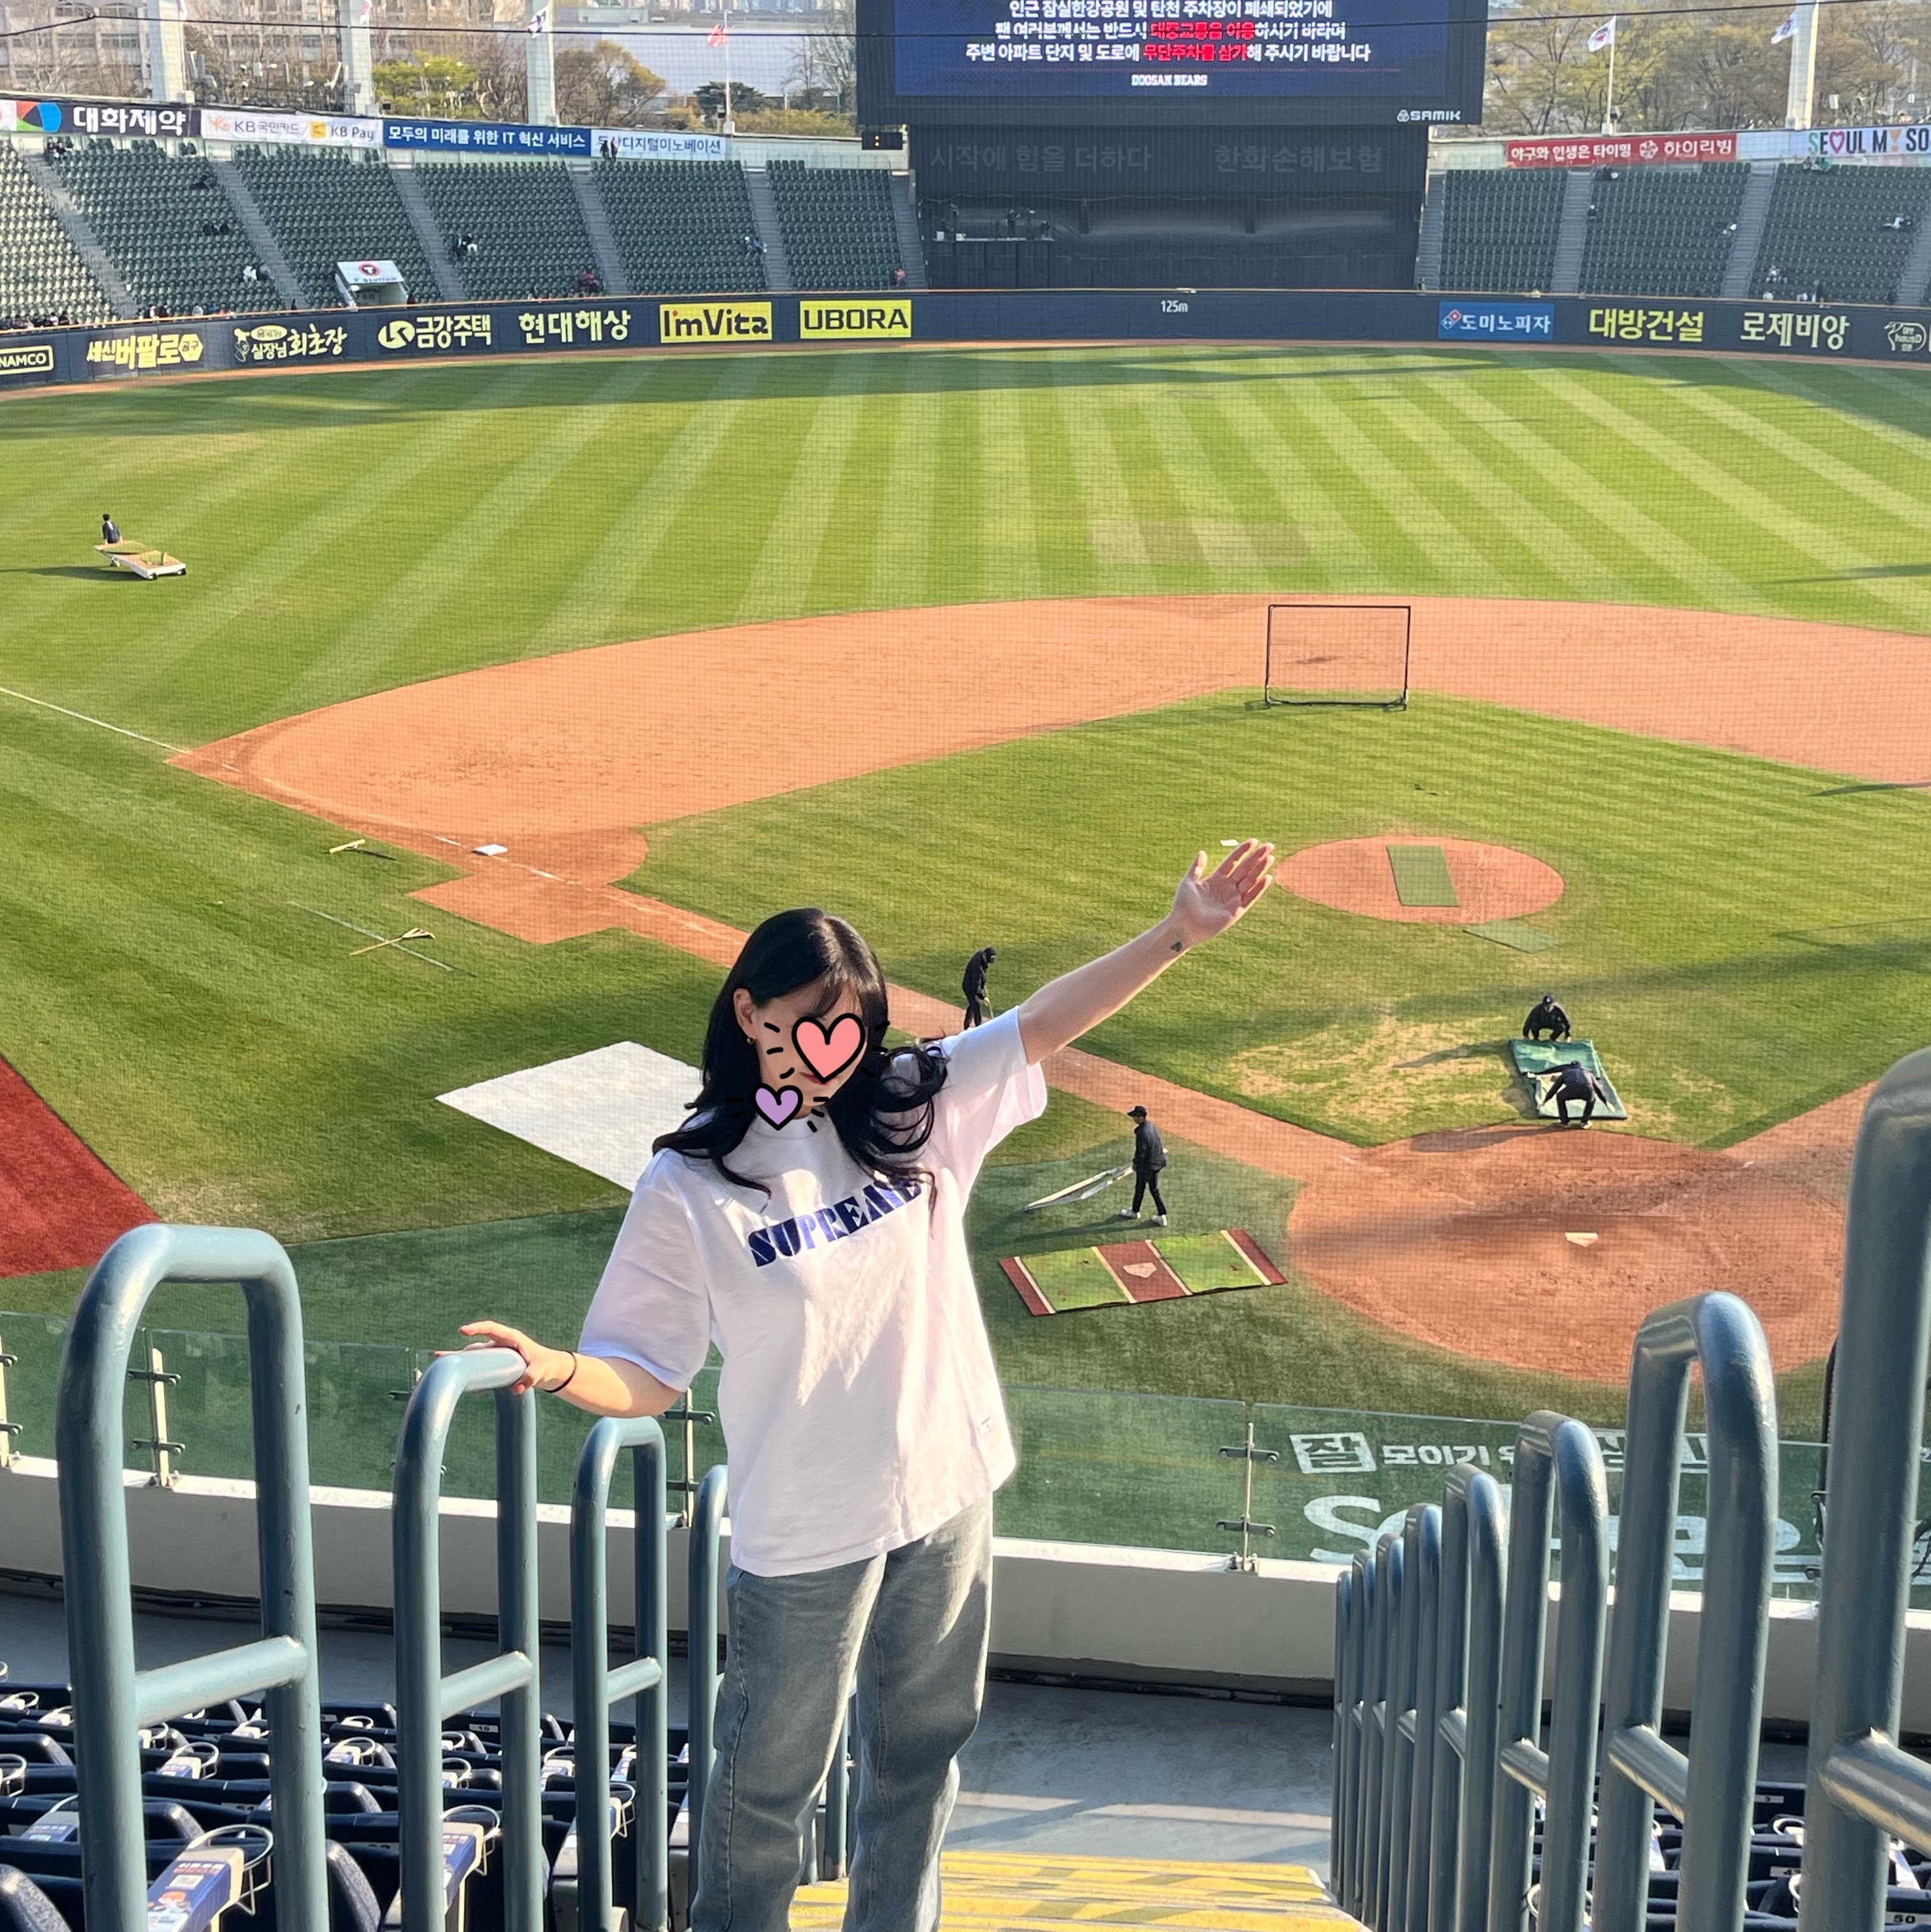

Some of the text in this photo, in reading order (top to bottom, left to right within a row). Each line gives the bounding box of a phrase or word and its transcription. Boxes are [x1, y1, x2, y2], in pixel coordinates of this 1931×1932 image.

[1009, 0, 1039, 18] 인근
[1132, 0, 1147, 18] 및
[1151, 0, 1180, 18] 탄천
[1183, 0, 1241, 18] 주차장이
[995, 22, 1011, 40] 팬
[1103, 22, 1147, 40] 반드시
[966, 43, 995, 62] 주변
[998, 43, 1042, 62] 아파트
[1046, 43, 1075, 62] 단지
[1078, 43, 1093, 62] 및
[1095, 43, 1140, 62] 도로에
[1264, 43, 1308, 62] 주시기
[1311, 43, 1370, 62] 바랍니다
[1131, 74, 1208, 86] DOOSAN BEARS
[73, 107, 186, 136] 대화제약
[1409, 110, 1461, 121] SAMIK
[331, 126, 347, 137] KB
[352, 127, 374, 141] Pay
[388, 126, 585, 148] 모두의 미래를 위한 IT 혁신 서비스
[931, 144, 1383, 173] 시작에 힘을 더하다 한화손해보험
[1511, 139, 1732, 162] 야구와 인생은 타이밍 하이리빙
[1161, 300, 1188, 312] 125m
[519, 310, 631, 344] 현대해상
[804, 308, 908, 330] UBORA
[1460, 314, 1551, 334] 도미노피자
[1589, 308, 1704, 342] 대방건설
[416, 314, 491, 349] 금강주택
[1740, 312, 1850, 350] 로제비앙
[1382, 1445, 1490, 1466] 모이기
[1893, 1915, 1916, 1924] 50
